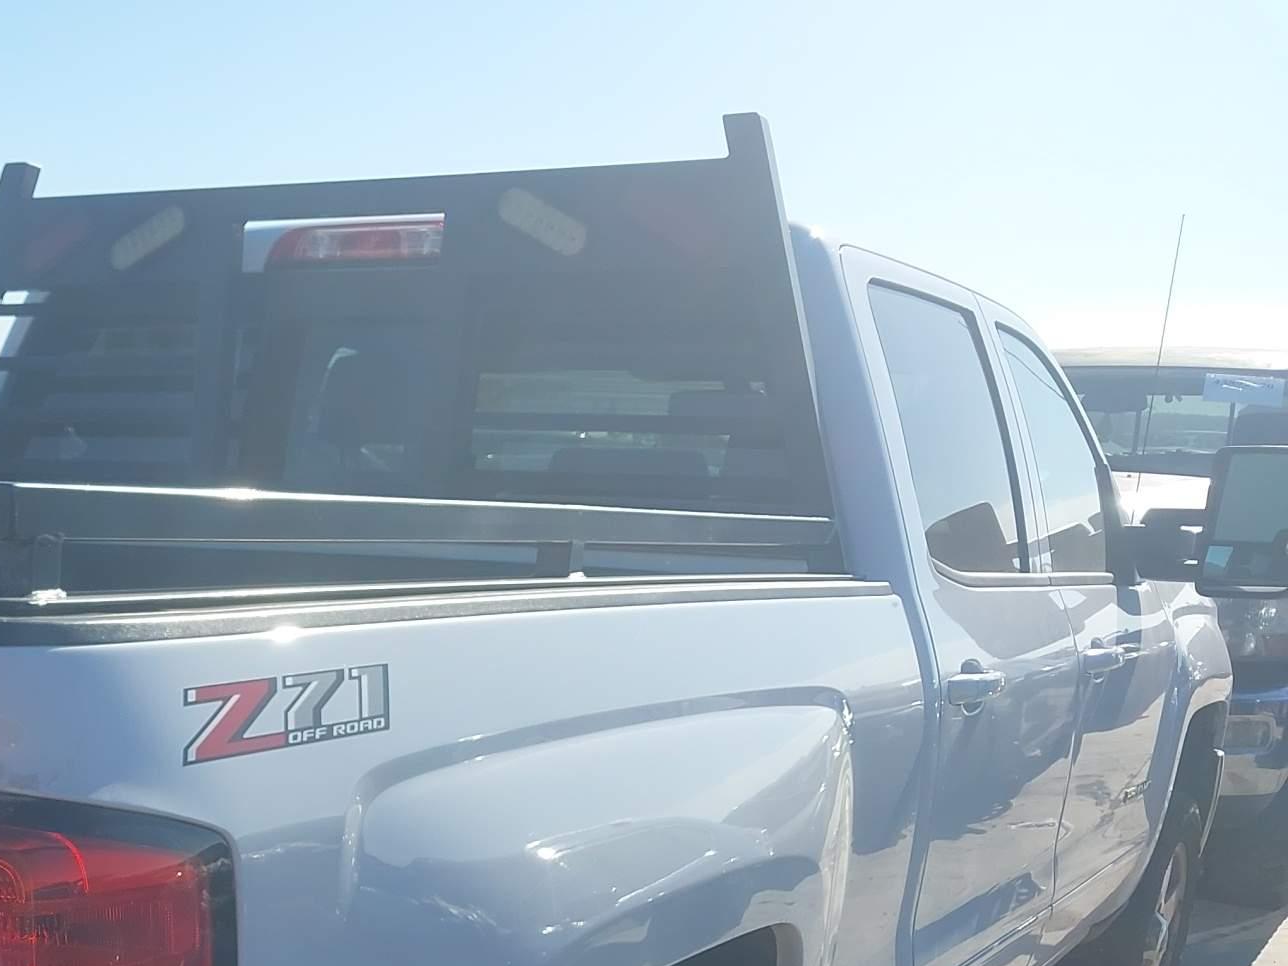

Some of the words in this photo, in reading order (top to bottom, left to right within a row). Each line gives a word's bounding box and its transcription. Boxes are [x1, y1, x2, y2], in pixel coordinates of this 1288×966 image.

[183, 663, 390, 766] Z71
[288, 727, 329, 745] OFF
[332, 717, 385, 737] ROAD
